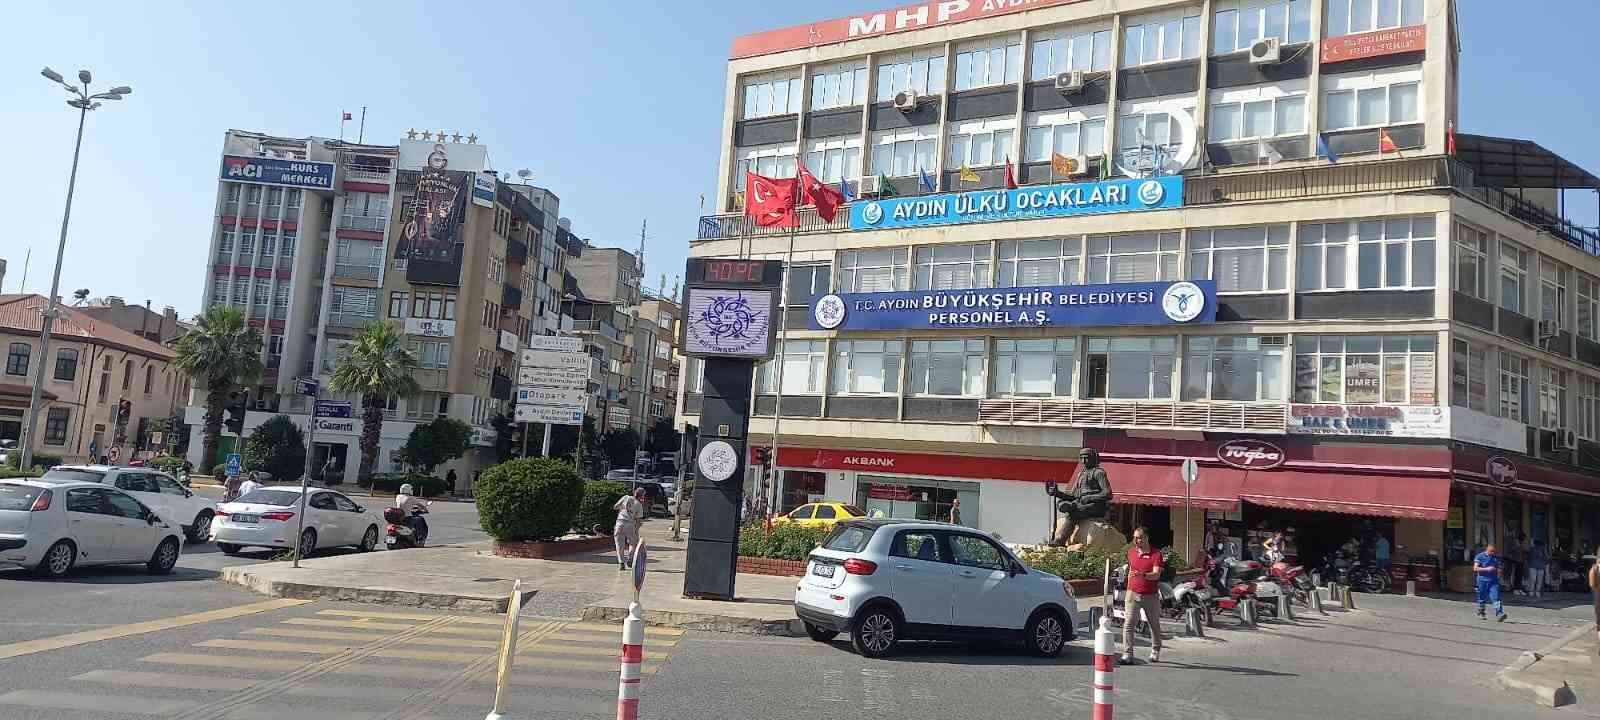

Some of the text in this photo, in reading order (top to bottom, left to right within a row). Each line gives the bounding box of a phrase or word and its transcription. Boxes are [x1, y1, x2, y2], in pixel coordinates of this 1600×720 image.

[848, 0, 971, 36] MHP
[290, 163, 320, 174] KURS
[280, 173, 328, 185] MERKEZİ
[893, 184, 1127, 218] AYDIN ÜLKÜ OCAKLARI
[855, 288, 1154, 311] T.C. AYDIN BÜYÜKŞEHİR BELEDİYESİ
[929, 310, 1051, 326] PERSONEL A.Ş.
[1347, 377, 1380, 387] UMRE
[528, 390, 567, 400] Otopark
[319, 420, 353, 432] Garanti
[842, 456, 895, 467] AKBANK
